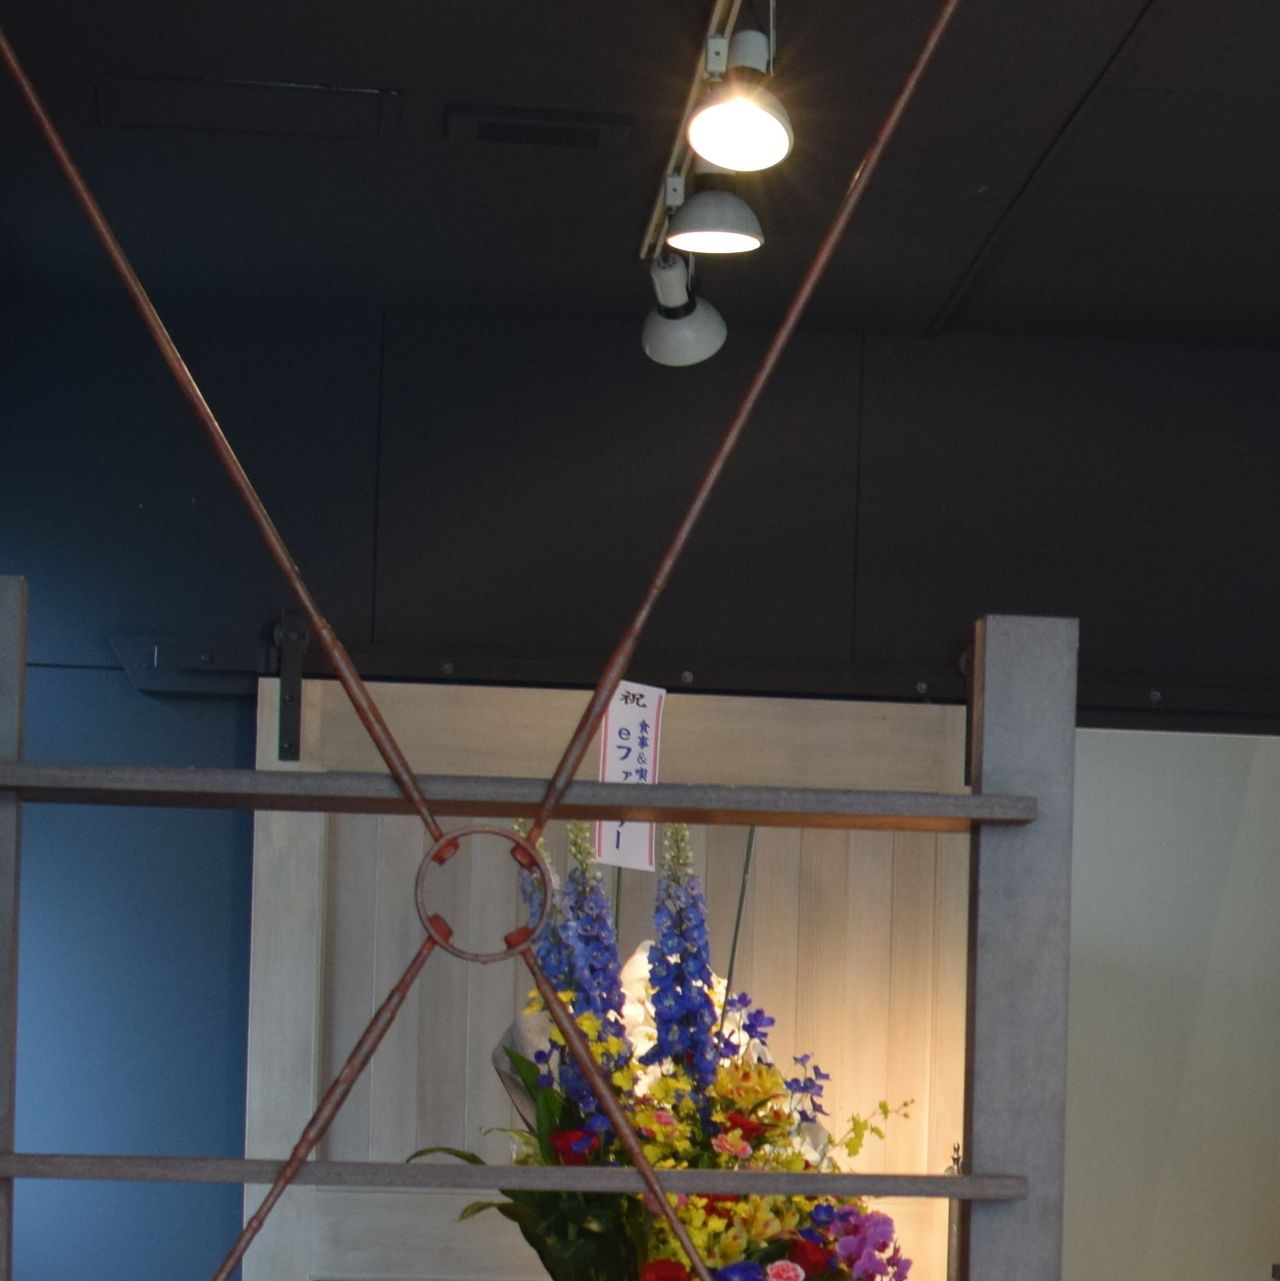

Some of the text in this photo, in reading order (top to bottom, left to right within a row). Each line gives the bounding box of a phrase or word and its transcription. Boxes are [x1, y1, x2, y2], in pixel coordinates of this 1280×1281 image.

[620, 691, 647, 708] 祝
[635, 719, 651, 784] 食事&喫
[615, 727, 633, 850] eファー
